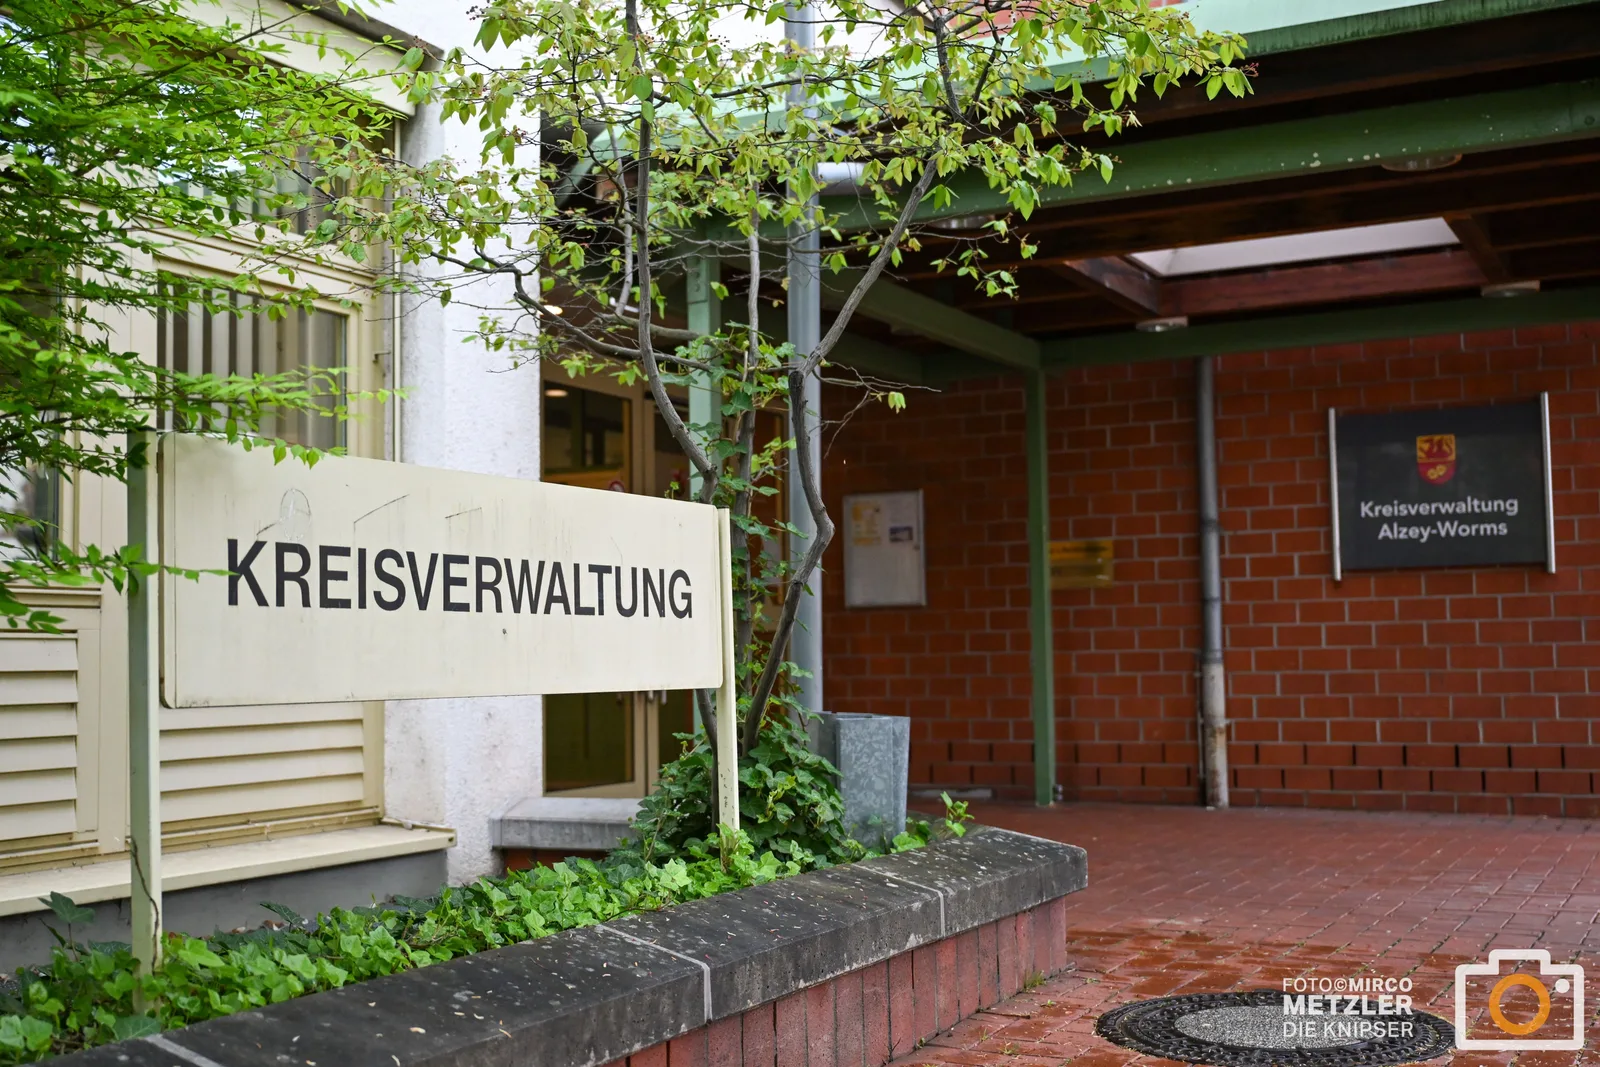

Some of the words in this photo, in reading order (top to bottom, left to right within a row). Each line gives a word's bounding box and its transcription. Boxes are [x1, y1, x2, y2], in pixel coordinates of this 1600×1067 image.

[1360, 495, 1519, 518] Kreisverwaltung
[1377, 520, 1508, 543] Alzey-Worms
[227, 538, 693, 619] KREISVERWALTUNG
